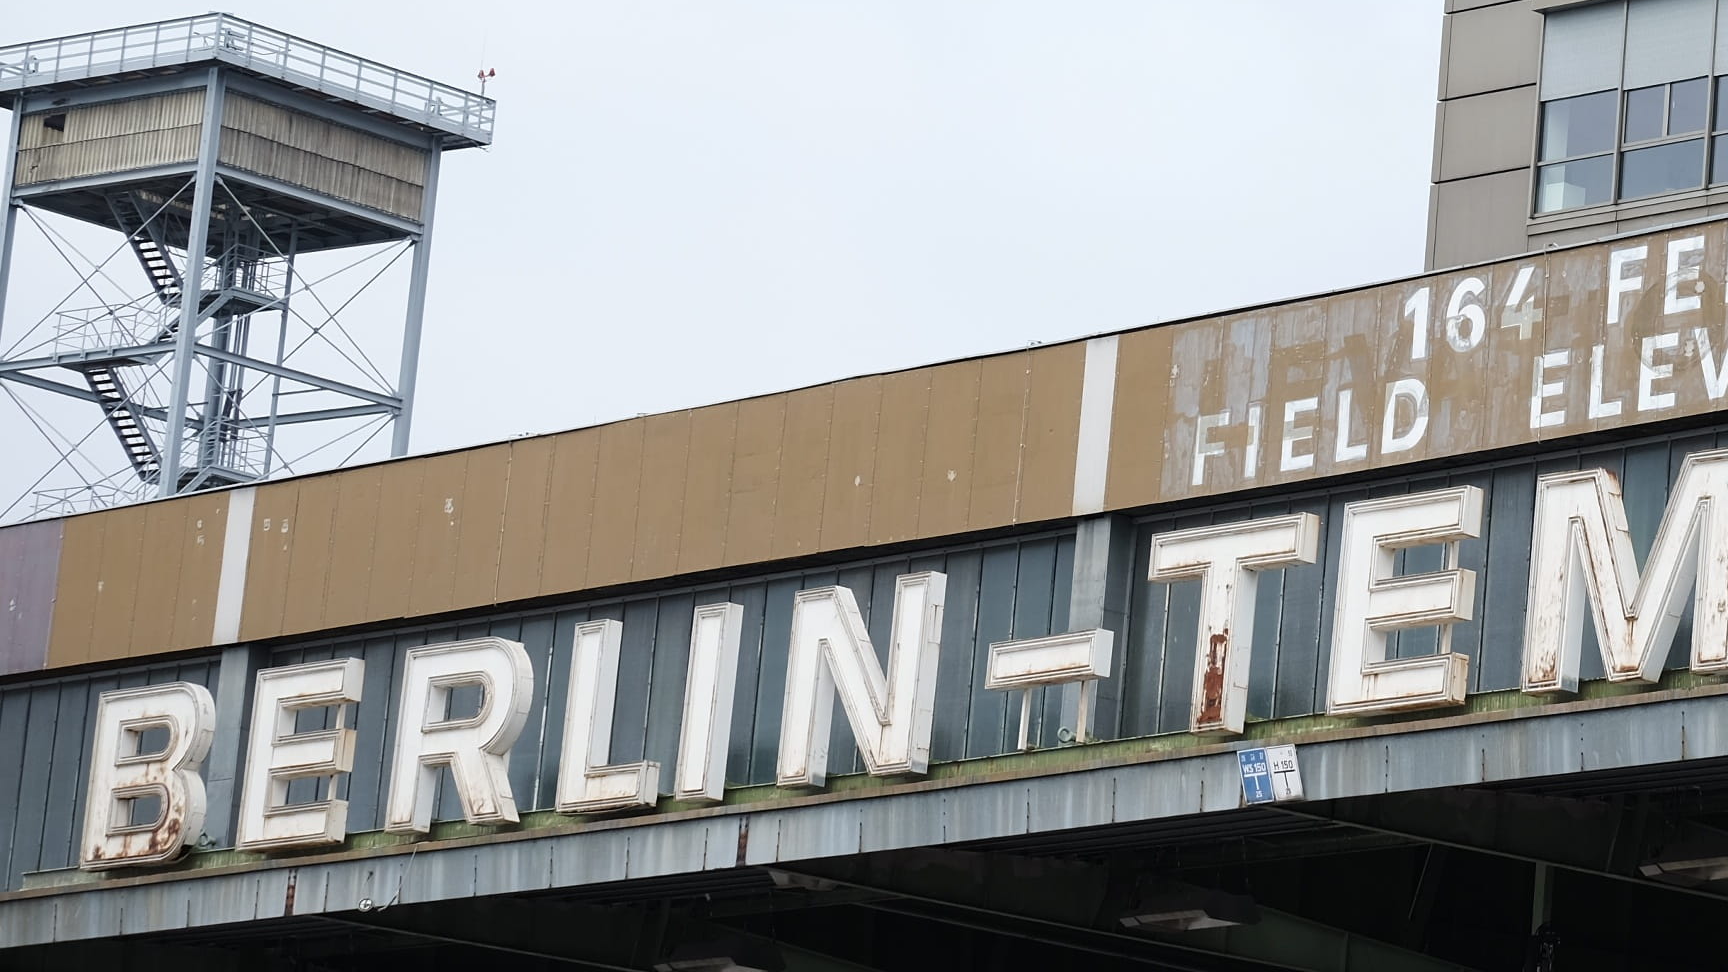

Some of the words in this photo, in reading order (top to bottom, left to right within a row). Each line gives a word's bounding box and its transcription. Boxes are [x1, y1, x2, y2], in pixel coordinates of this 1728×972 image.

[1403, 265, 1543, 361] 164
[1191, 378, 1430, 487] FIELD
[1273, 761, 1280, 770] H
[1280, 759, 1294, 769] 150
